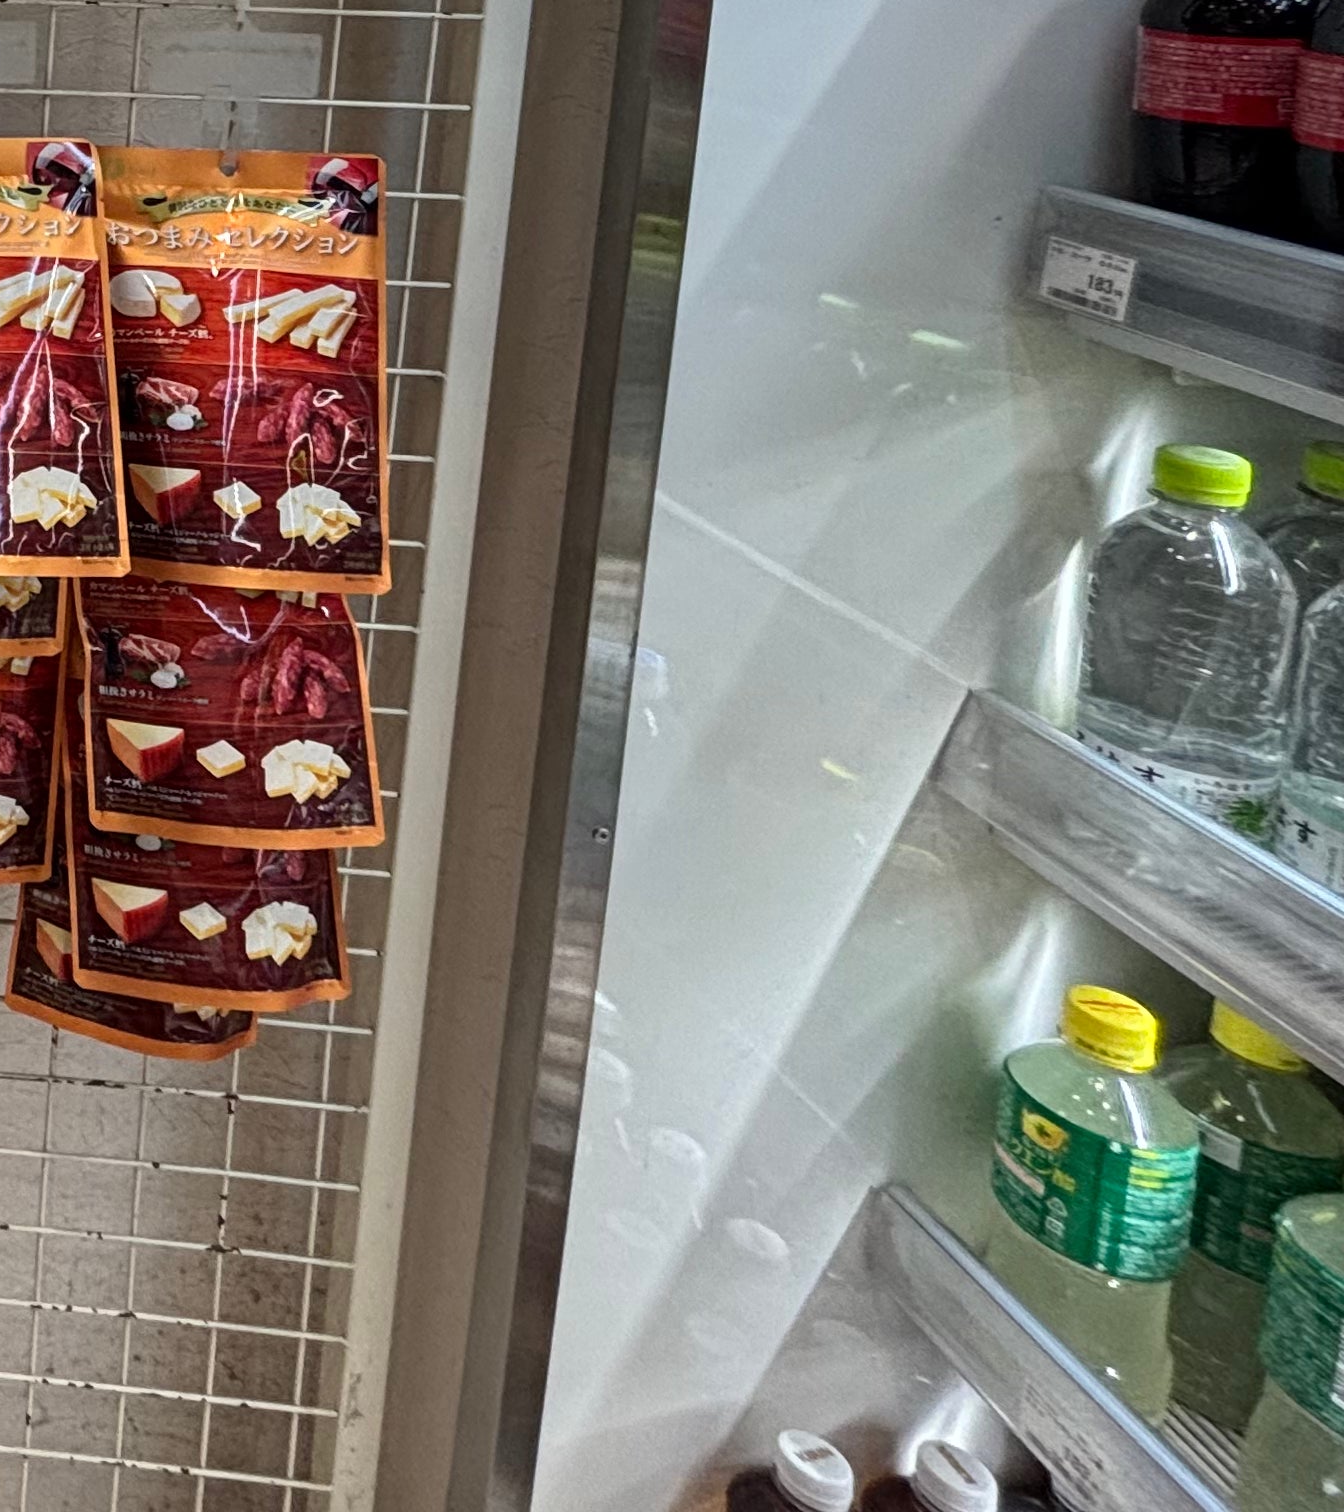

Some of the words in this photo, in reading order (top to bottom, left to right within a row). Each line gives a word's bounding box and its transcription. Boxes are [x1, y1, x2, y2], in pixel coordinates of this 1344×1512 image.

[106, 219, 361, 258] おつまみセレクション
